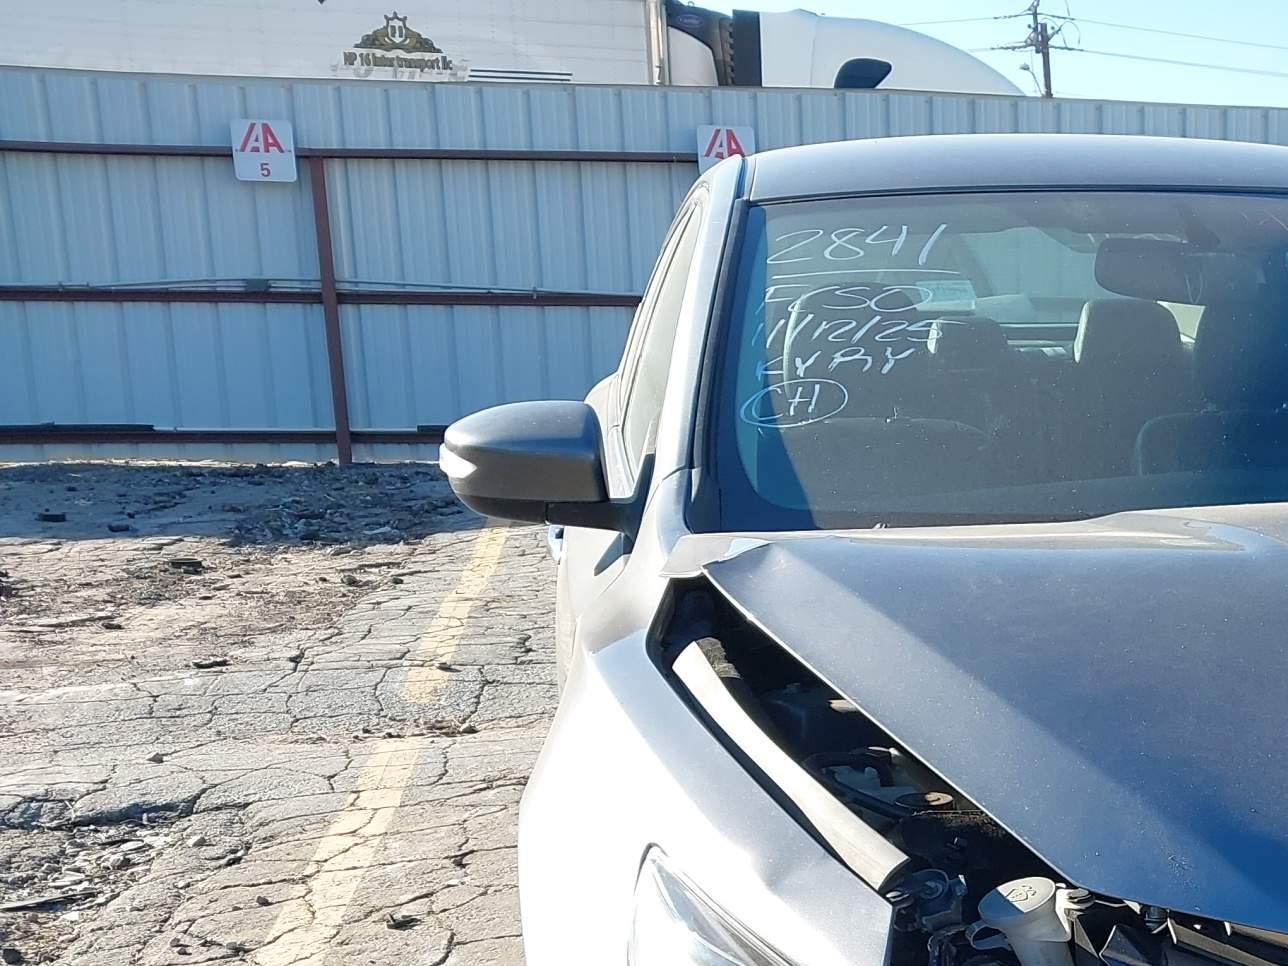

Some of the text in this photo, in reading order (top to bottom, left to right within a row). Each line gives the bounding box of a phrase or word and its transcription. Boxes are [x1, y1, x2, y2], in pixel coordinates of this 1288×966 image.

[358, 52, 371, 67] 16
[260, 162, 271, 178] 5
[766, 223, 949, 266] 2841
